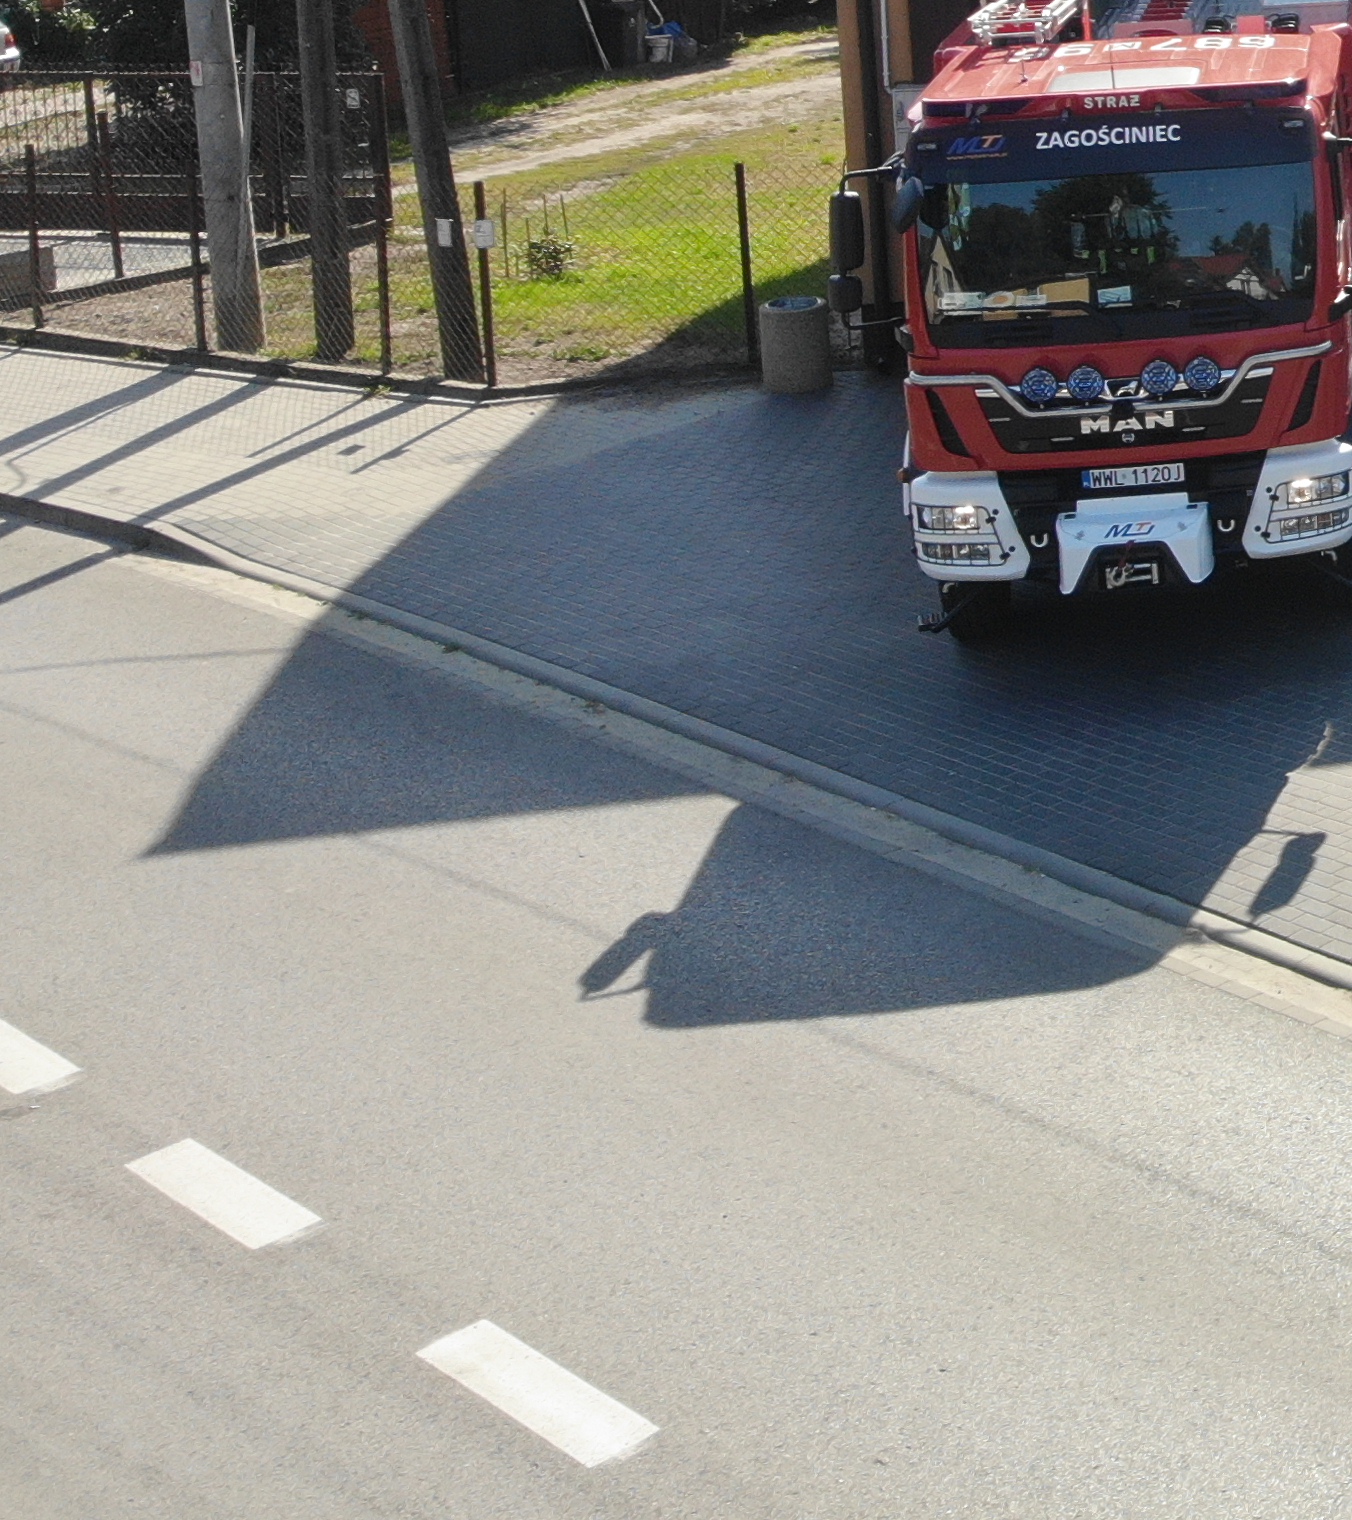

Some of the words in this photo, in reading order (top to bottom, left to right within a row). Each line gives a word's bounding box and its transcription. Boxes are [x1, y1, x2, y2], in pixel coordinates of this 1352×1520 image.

[1035, 125, 1181, 150] ZAGOŚCINIEC
[1080, 410, 1175, 435] MAN
[1091, 470, 1125, 488] WWL
[1131, 465, 1182, 485] 1120J
